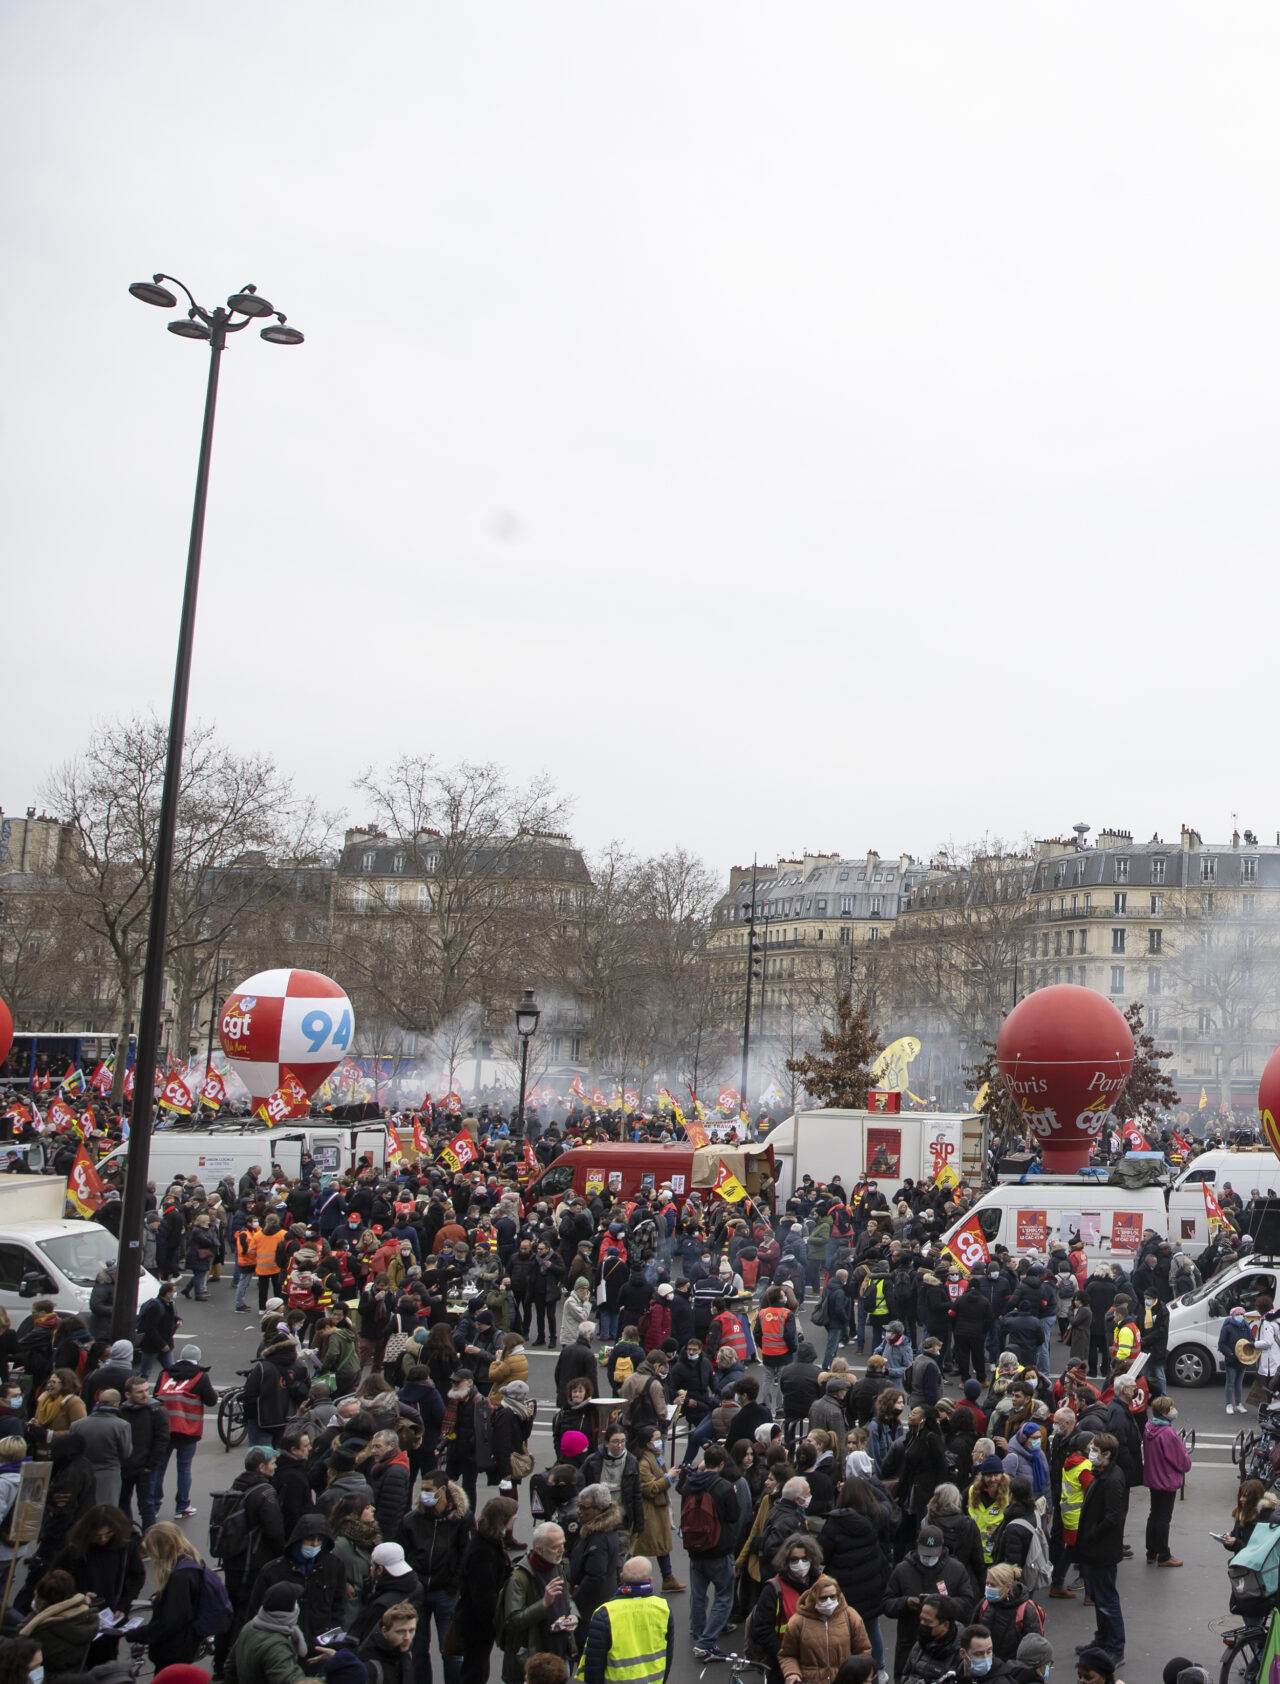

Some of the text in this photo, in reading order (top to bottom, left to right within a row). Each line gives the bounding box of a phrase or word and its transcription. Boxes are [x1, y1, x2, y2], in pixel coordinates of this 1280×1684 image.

[223, 1014, 252, 1039] cgt
[301, 1009, 351, 1052] 94
[1006, 1073, 1048, 1095] Paris
[52, 1105, 70, 1126] cgt
[1022, 1107, 1062, 1136] cgt
[589, 1173, 602, 1182] cgt
[957, 1232, 985, 1267] cg
